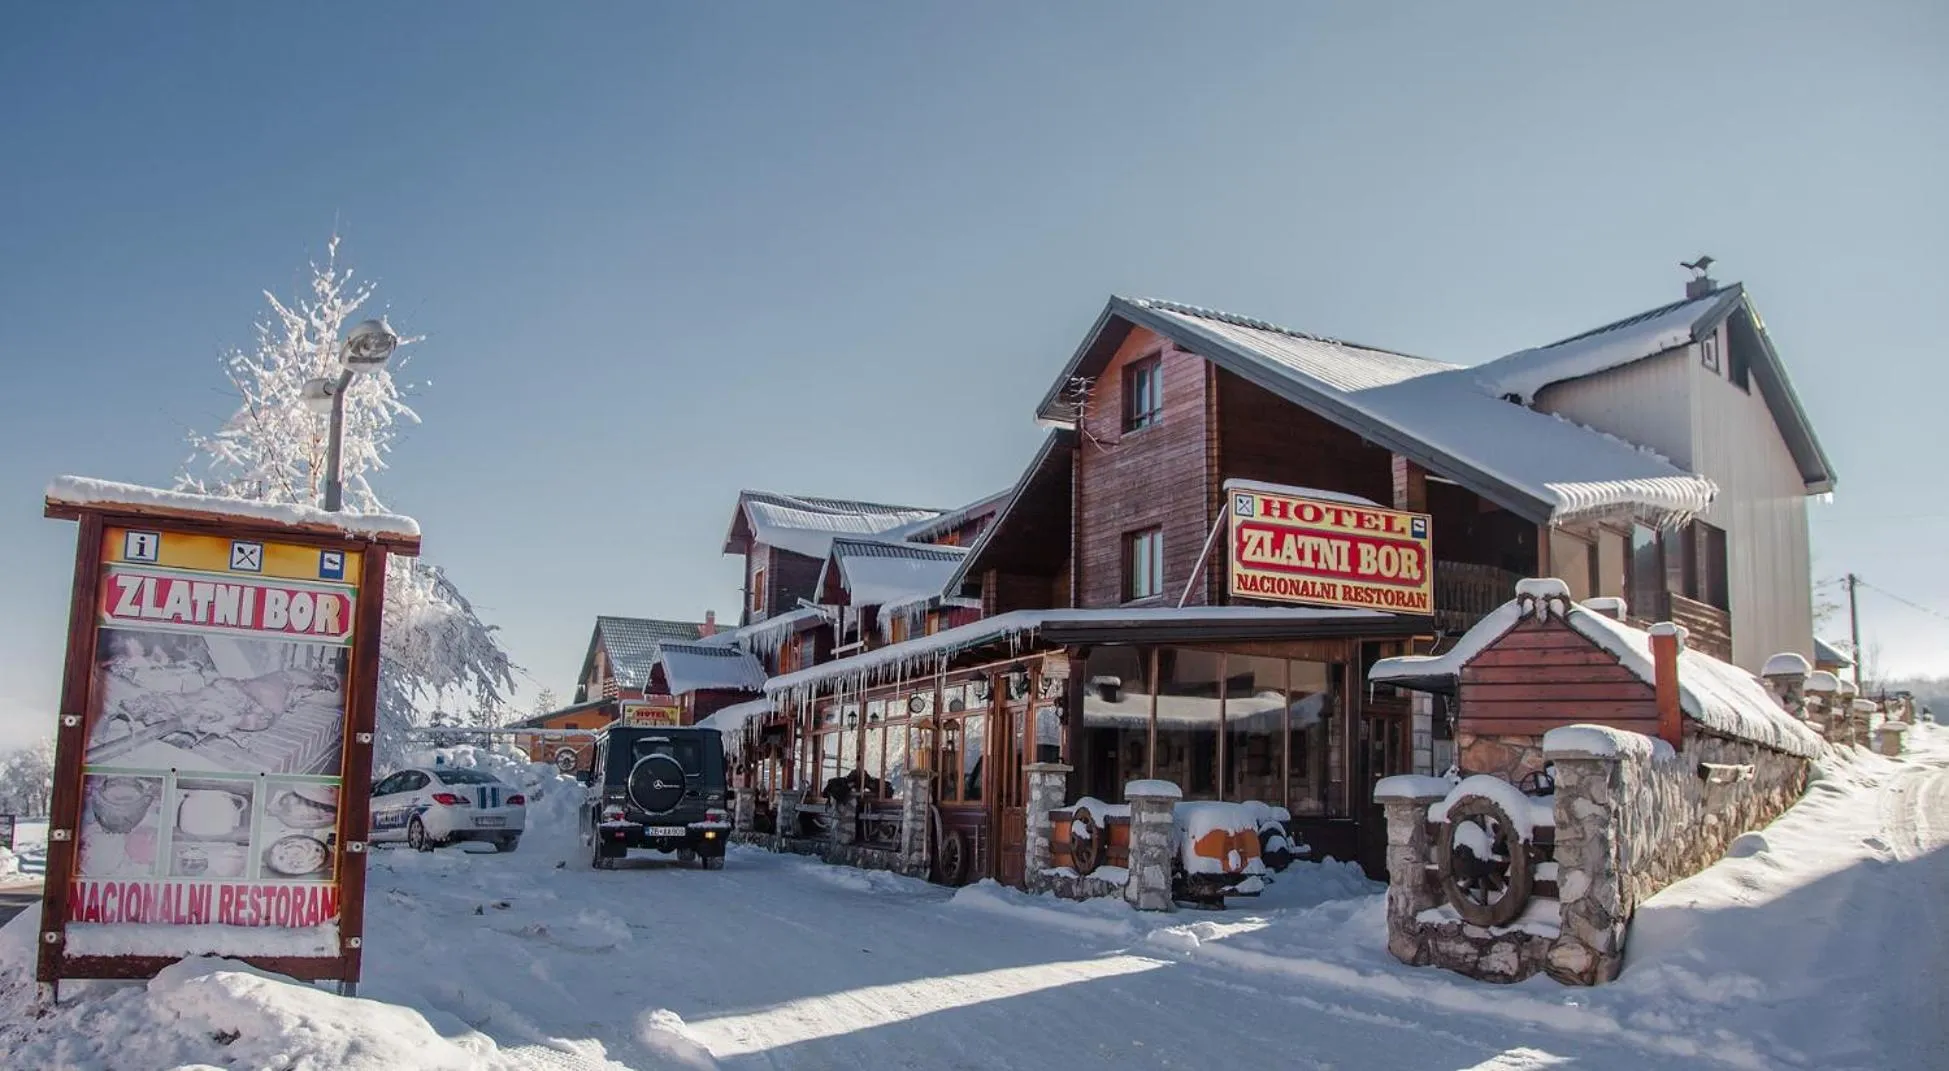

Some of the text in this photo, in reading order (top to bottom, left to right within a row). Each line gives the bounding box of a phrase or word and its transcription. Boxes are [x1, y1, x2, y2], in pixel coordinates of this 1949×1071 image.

[1260, 498, 1407, 535] HOTEL
[1242, 528, 1421, 580] ZLATNI BOR
[112, 574, 342, 635] ZLATNI BOR
[1236, 573, 1427, 609] NACIONALNI RESTORAN
[68, 881, 338, 928] NACIONALNI RESTORAN
